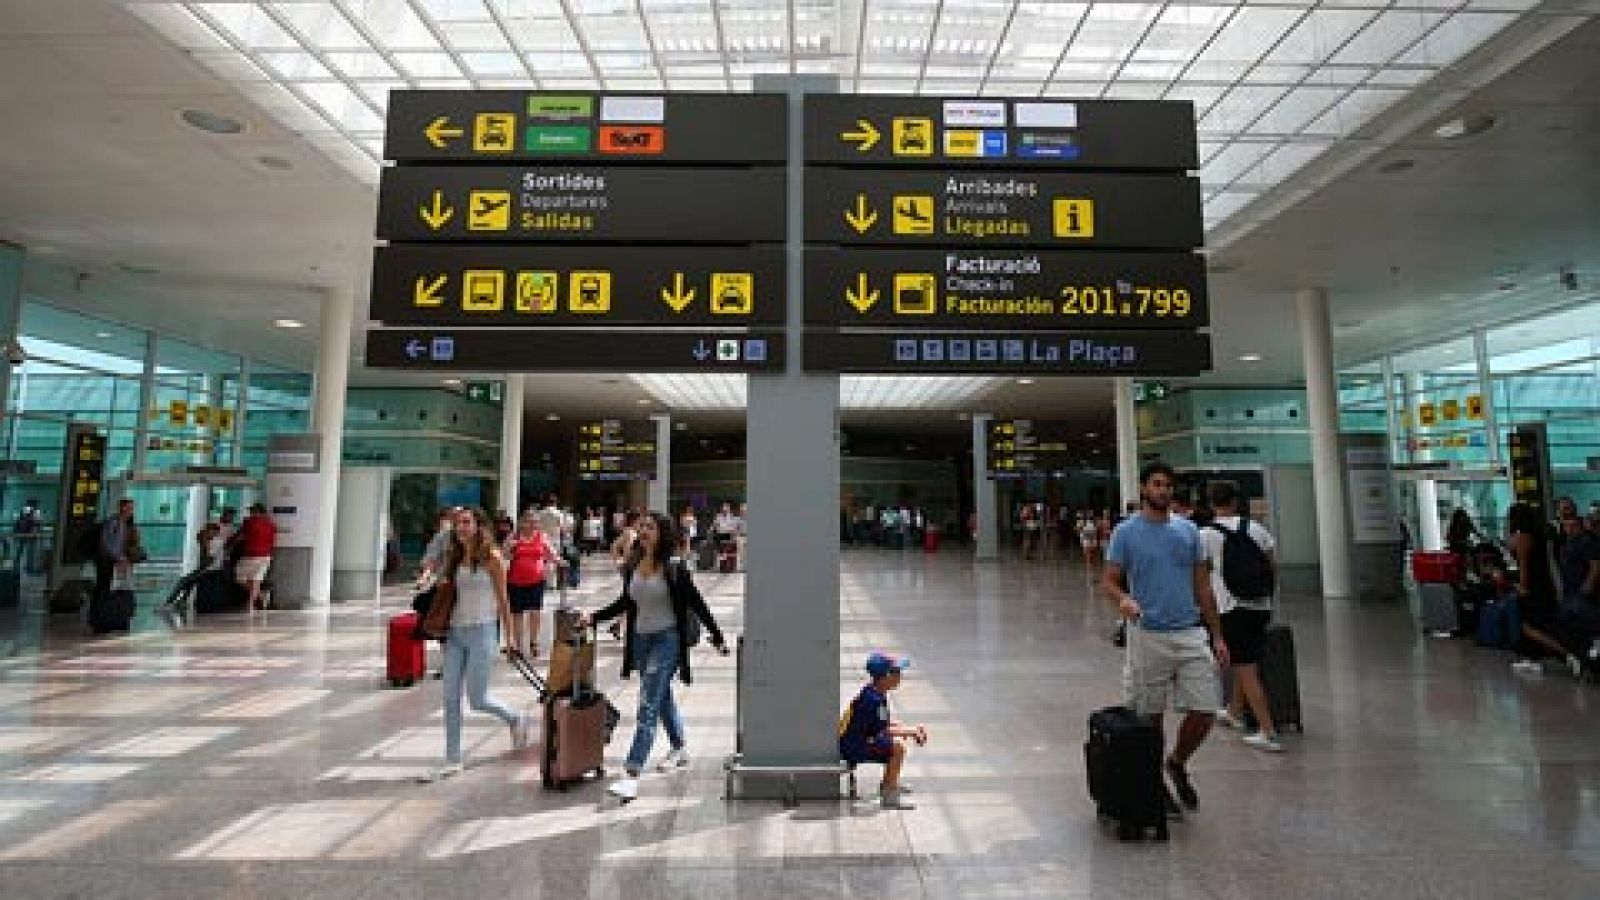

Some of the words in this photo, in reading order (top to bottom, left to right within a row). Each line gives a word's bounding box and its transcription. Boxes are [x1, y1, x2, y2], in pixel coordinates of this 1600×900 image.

[522, 172, 606, 191] Sortides
[946, 176, 1038, 197] Arribades
[522, 212, 594, 231] Salidas
[946, 216, 1031, 238] Llegadas
[946, 254, 1041, 274] Facturació
[946, 295, 1054, 314] Facturación
[1029, 340, 1060, 361] La
[1069, 339, 1136, 367] Plaça
